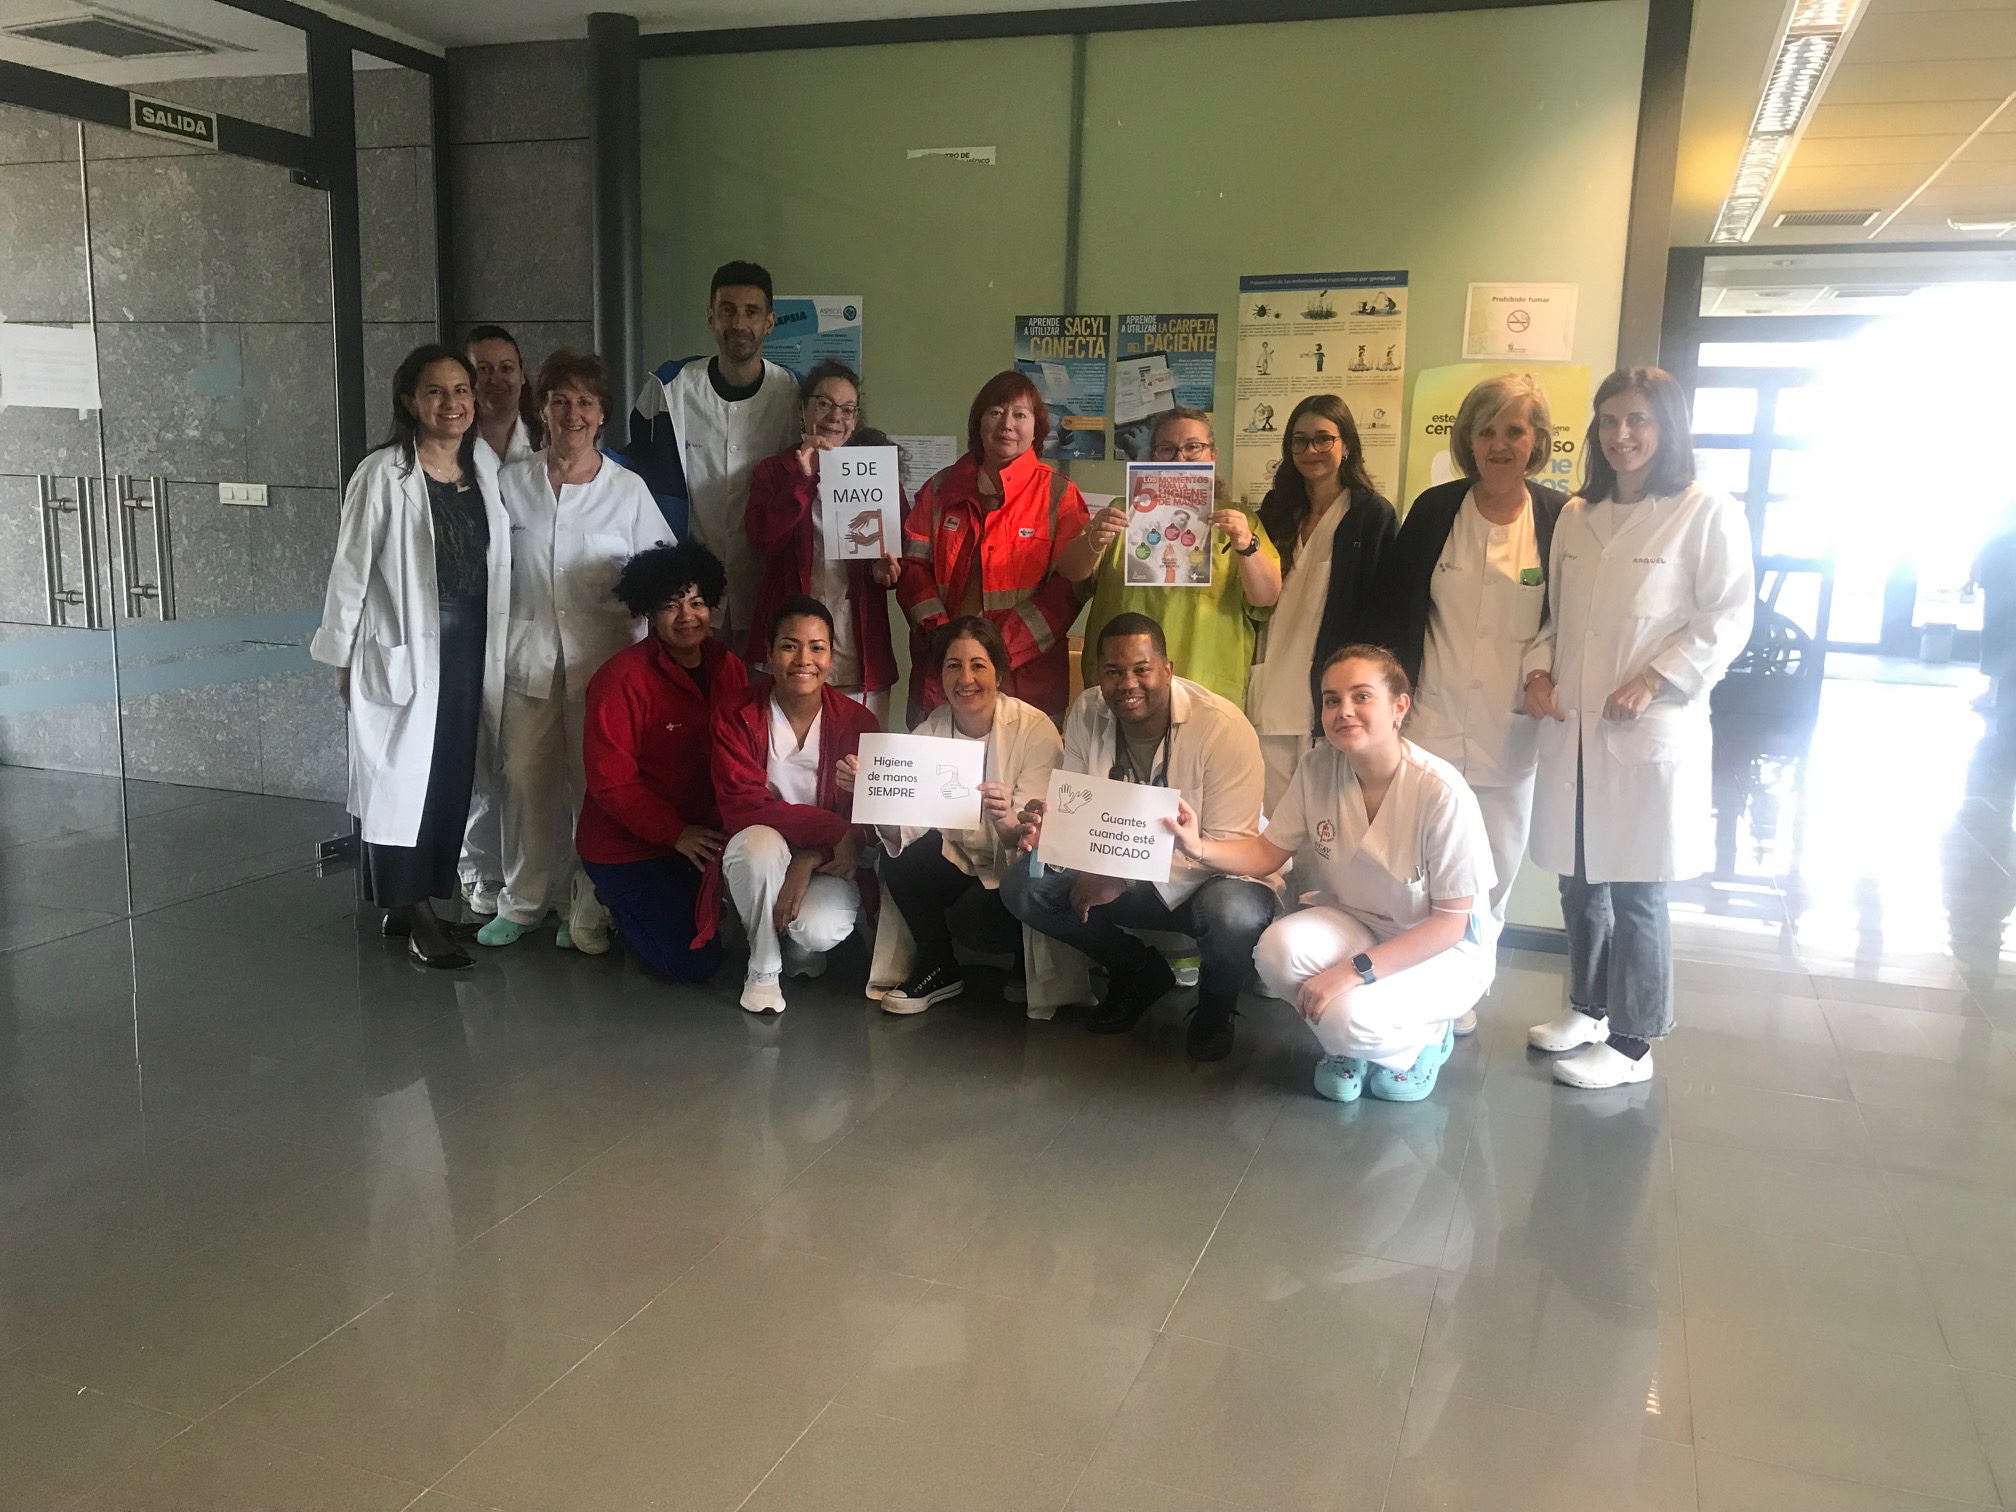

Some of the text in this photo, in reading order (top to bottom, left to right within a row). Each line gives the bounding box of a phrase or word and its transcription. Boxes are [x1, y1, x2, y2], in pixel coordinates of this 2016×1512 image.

[142, 106, 207, 136] SALIDA
[1028, 317, 1060, 327] APRENDE
[1064, 317, 1107, 336] SACYL
[1126, 315, 1157, 324] APRENDE
[1158, 318, 1215, 334] LA CARPETA
[1023, 326, 1060, 336] A UTILIZAR
[1121, 324, 1157, 334] A UTILIZAR
[1029, 336, 1106, 359] CONECTA
[1143, 333, 1216, 352] PACIENTE
[1432, 414, 1456, 423] este
[841, 462, 878, 476] 5 DE
[1158, 476, 1209, 484] MOMENTOS
[833, 488, 883, 503] MAYO
[1132, 476, 1159, 513] 5
[1158, 489, 1208, 499] HIGIENE
[873, 756, 914, 768] Higiene
[867, 771, 918, 783] de manos
[868, 786, 915, 798] SIEMPRE
[1101, 812, 1147, 828] Guantes
[1089, 828, 1155, 845] cuando esté
[1089, 842, 1150, 860] INDICADO
